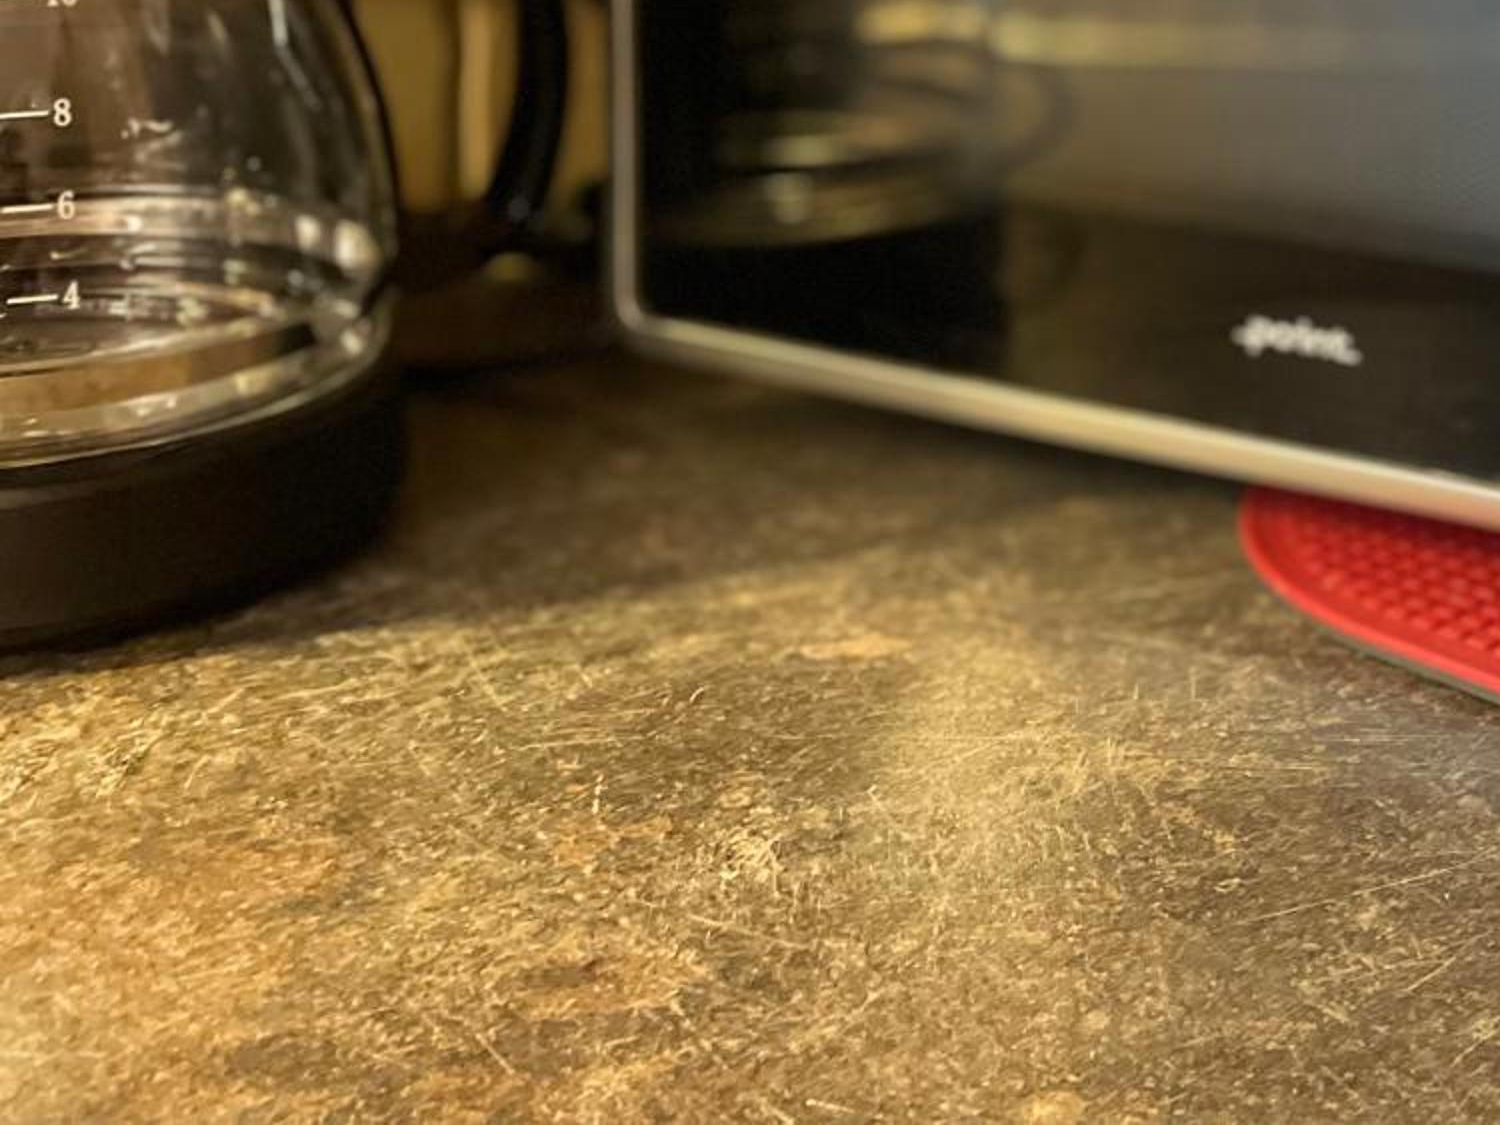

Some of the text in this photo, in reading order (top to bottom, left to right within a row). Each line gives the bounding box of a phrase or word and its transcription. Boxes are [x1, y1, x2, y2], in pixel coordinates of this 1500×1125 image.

[53, 98, 72, 127] 8
[57, 190, 75, 220] 6
[62, 281, 81, 310] 4
